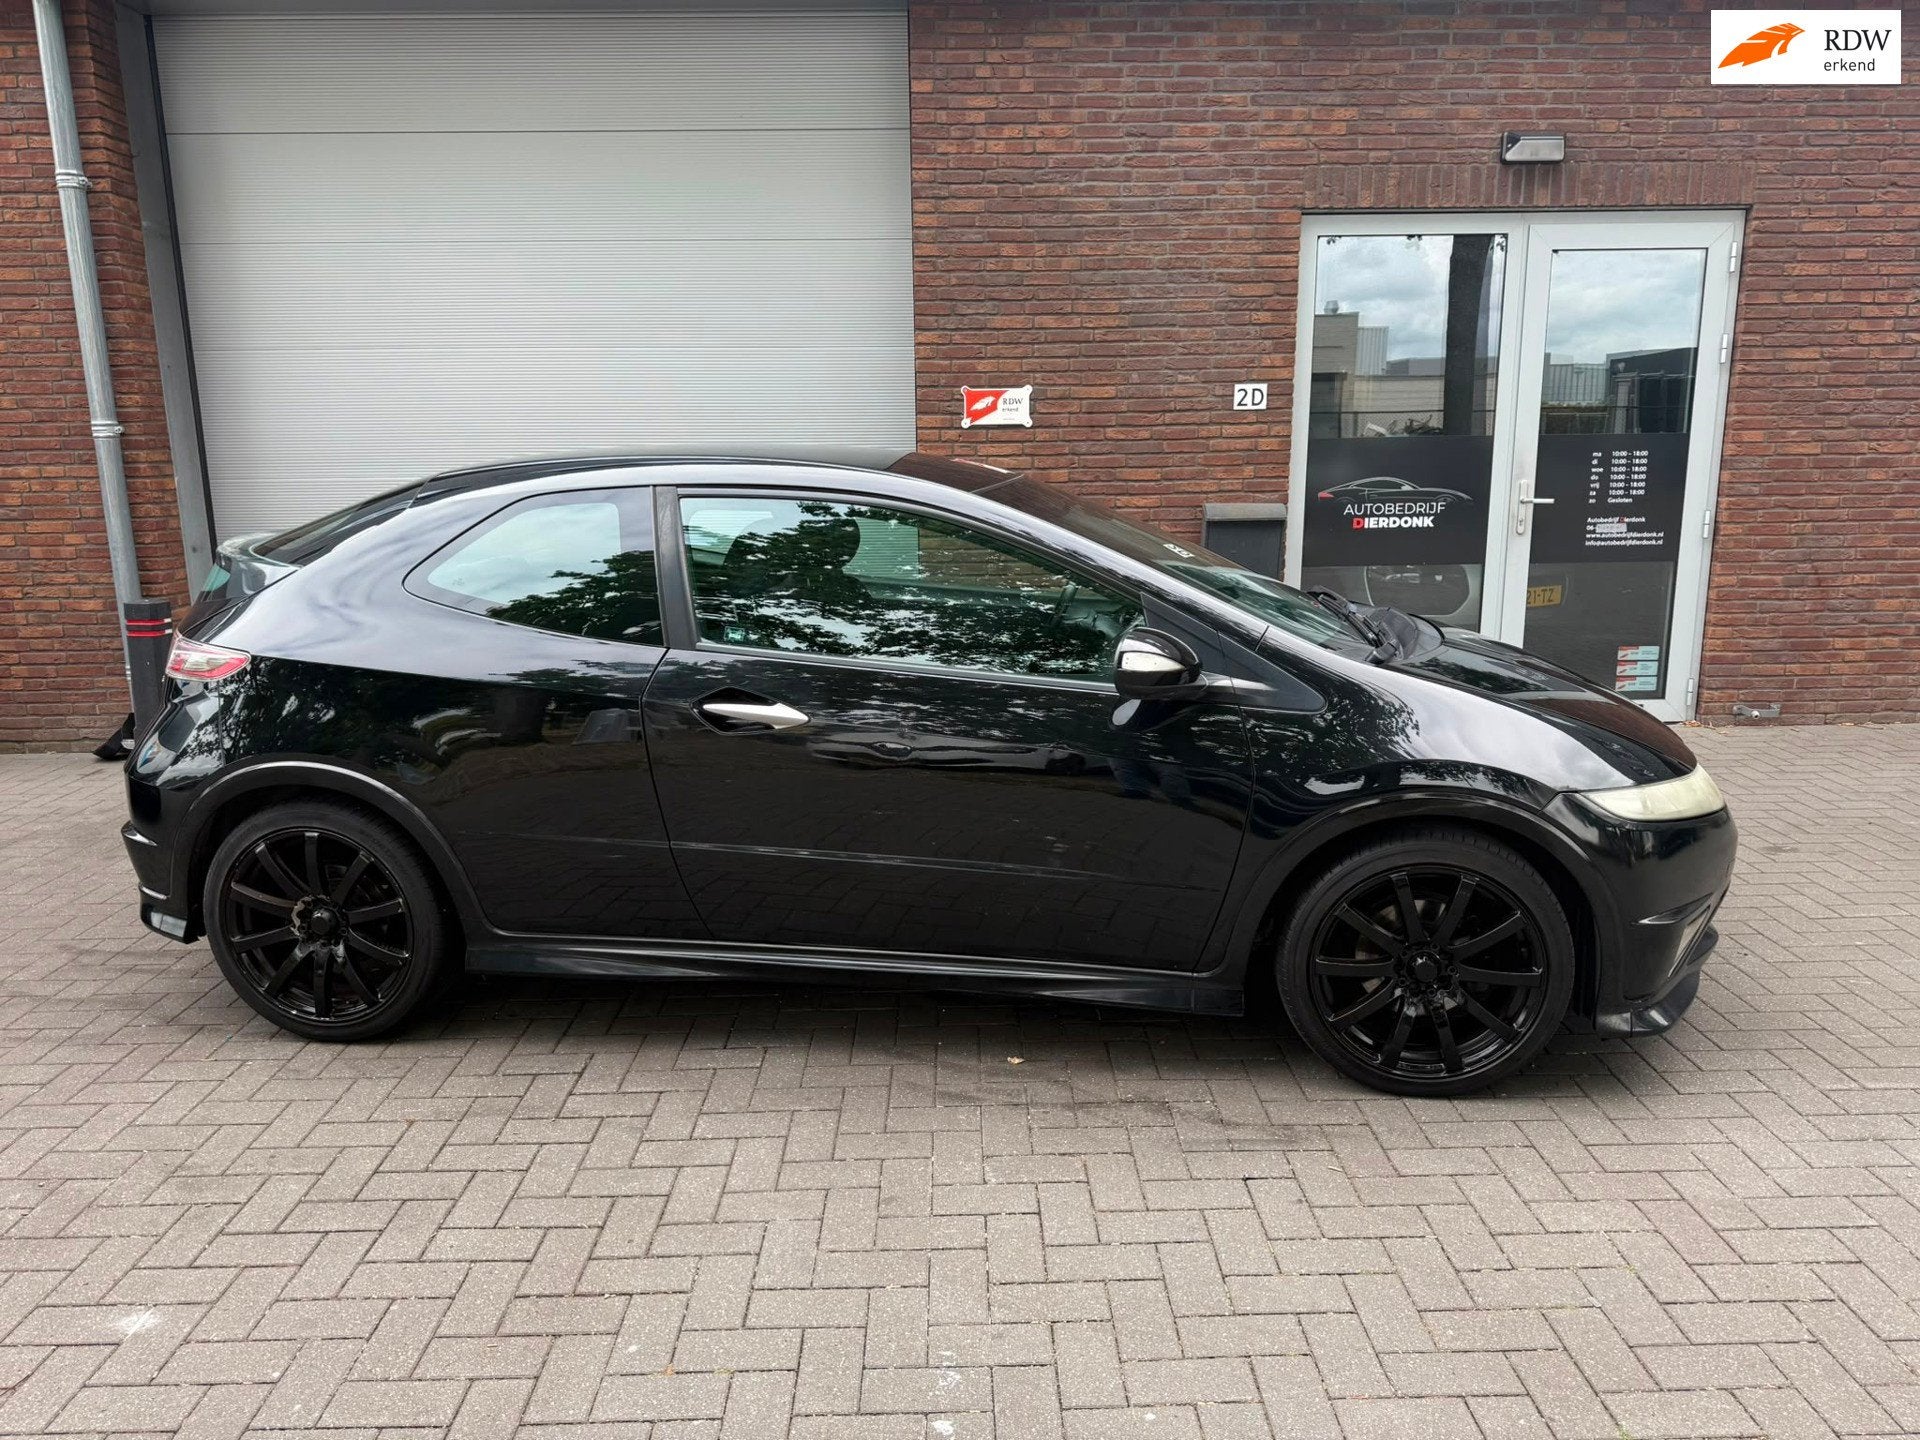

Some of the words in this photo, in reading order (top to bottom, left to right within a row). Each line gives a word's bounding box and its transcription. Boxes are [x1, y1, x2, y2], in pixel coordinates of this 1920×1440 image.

[1237, 388, 1264, 406] 2D
[1343, 502, 1446, 516] AUTOBEDRIJF
[1352, 516, 1434, 529] DIERDONK
